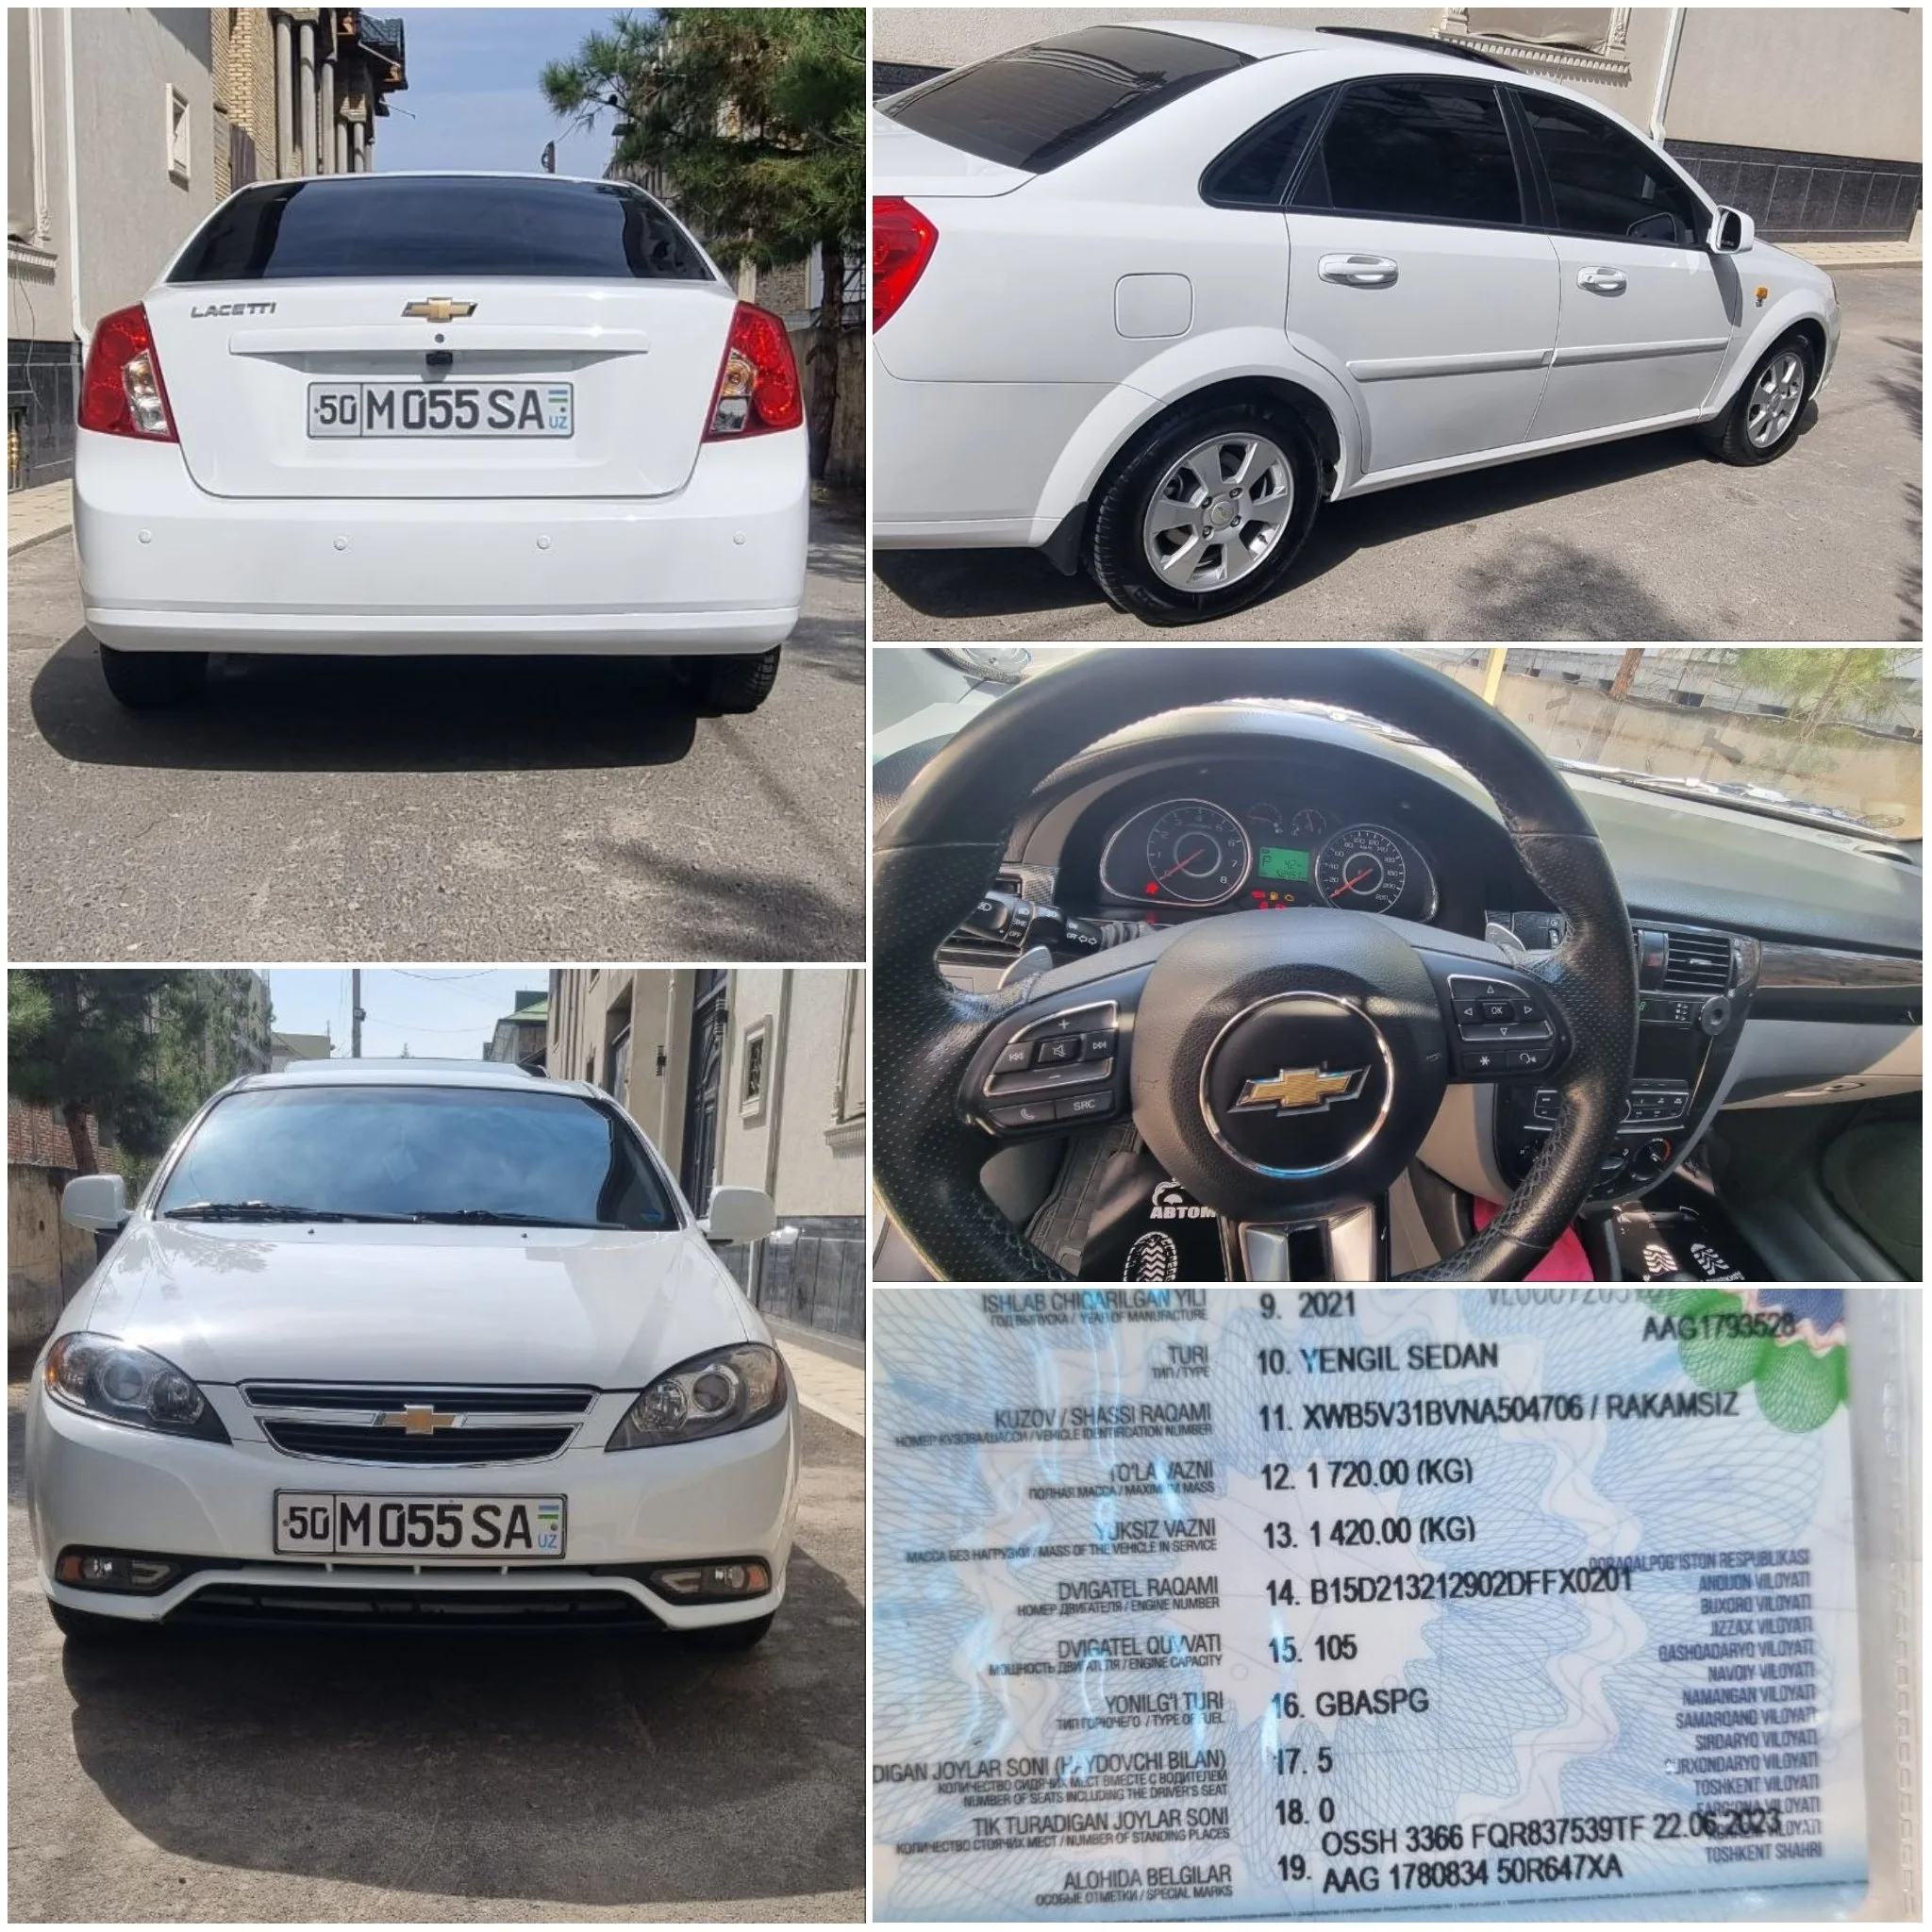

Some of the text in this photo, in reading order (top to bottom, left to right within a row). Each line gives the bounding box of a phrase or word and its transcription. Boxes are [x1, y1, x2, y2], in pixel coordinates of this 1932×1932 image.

[191, 302, 276, 318] LACETTI
[320, 395, 357, 425] 50
[548, 416, 567, 429] UZ
[1491, 1007, 1503, 1015] OK
[1074, 1099, 1096, 1111] SRC
[982, 1292, 1045, 1314] ISHLAB
[1174, 1289, 1207, 1307] YILI
[1299, 1291, 1355, 1318] 2021
[1168, 1345, 1208, 1364] TURI
[1257, 1342, 1498, 1374] 10. YENGIL SEDAN
[1183, 1367, 1210, 1378] TYPE
[995, 1403, 1211, 1428] KUZOV SHASSI RAQAMI
[1259, 1405, 1292, 1431] 11.
[1303, 1394, 1584, 1430] XWB5V31BVNA504706
[1606, 1391, 1740, 1420] RAKAMSIZ
[1260, 1463, 1295, 1490] 12.
[1417, 1457, 1474, 1485] (KG)
[1183, 1481, 1215, 1493] MASS
[289, 1507, 329, 1540] 50
[1164, 1518, 1216, 1538] VAZNI
[1263, 1522, 1298, 1548] 13.
[1420, 1516, 1475, 1544] (KG)
[538, 1534, 557, 1549] UZ
[1039, 1545, 1071, 1557] MASS
[1074, 1544, 1087, 1556] OF
[1090, 1543, 1110, 1556] THE
[1113, 1542, 1157, 1555] VEHICLE
[1159, 1541, 1170, 1553] IN
[1173, 1540, 1217, 1552] SERVICE
[1719, 1549, 1810, 1568] RESPUBLIKASI
[1058, 1576, 1219, 1600] DVIGATEL RAQAMI
[1756, 1571, 1810, 1590] VILOYATI
[1266, 1579, 1300, 1606] 14.
[1132, 1599, 1169, 1611] ENGINE
[1174, 1597, 1220, 1609] NUMBER
[1701, 1593, 1812, 1615] BUXORO VILOYATI
[1709, 1616, 1813, 1637] JIZZAX VILOYATI
[1058, 1638, 1141, 1658] DVIGATEL
[1269, 1634, 1357, 1663] 15. 105
[1758, 1639, 1814, 1657] VILOYATI
[1130, 1656, 1222, 1670] ENGINE CAPACITY
[1708, 1661, 1815, 1682] NAVOIY VILOYATI
[1183, 1690, 1224, 1710] TURI
[1270, 1688, 1429, 1719] 16. GBASPG
[1682, 1684, 1816, 1706] NAMANGAN VILOYATI
[1152, 1714, 1178, 1726] TYPE
[1695, 1728, 1818, 1751] SIRDARYO VILOYATI
[873, 1763, 927, 1783] DIGAN
[933, 1759, 1001, 1780] JOYLAR
[1007, 1757, 1049, 1777] SONI
[1168, 1750, 1226, 1771] BILAN)
[1317, 1746, 1333, 1774] 5
[1763, 1751, 1819, 1770] VILOYATI
[964, 1785, 1227, 1807] NUMBER OF SEATS INCLUDING THE DRIVER'S SEAT
[1694, 1774, 1820, 1796] TOSHKENT VILOYATI
[973, 1807, 1229, 1837] TIK TURADIGAN JOYLAR SONI
[1274, 1798, 1309, 1825] 18.
[1067, 1834, 1113, 1847] NUMBER
[1116, 1833, 1129, 1844] OF
[1132, 1830, 1187, 1844] STANDING
[1189, 1828, 1230, 1841] PLACES
[1322, 1828, 1397, 1856] OSSH
[1406, 1824, 1463, 1852] 3366
[1471, 1814, 1645, 1849] FQR837539TF
[1653, 1807, 1781, 1840] 22.06.2023
[1706, 1840, 1822, 1864] TOSHKENT SHAHRI
[1063, 1864, 1231, 1890] ALOHIDA BELGILAR
[1277, 1853, 1623, 1894] 19. AAG 1780834 50R647XA
[1147, 1887, 1191, 1901] SPECIAL
[1193, 1885, 1233, 1898] MARKS
